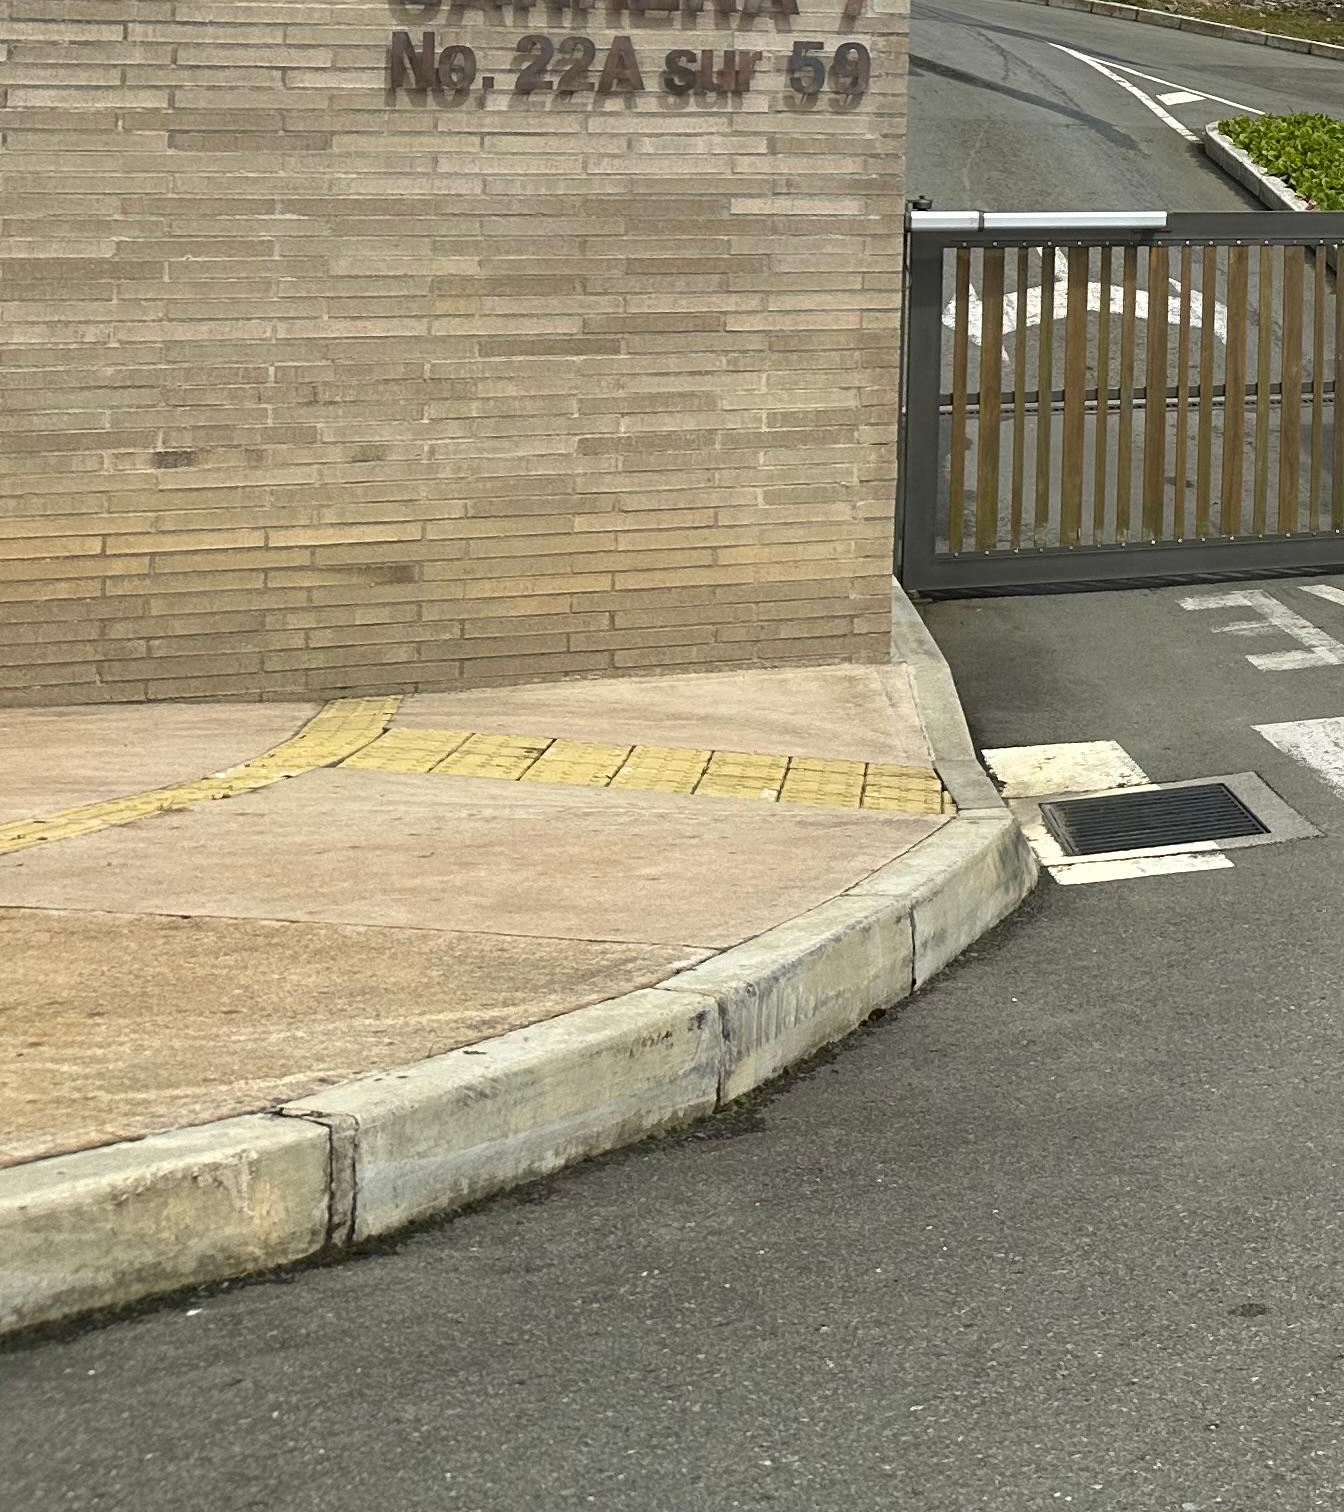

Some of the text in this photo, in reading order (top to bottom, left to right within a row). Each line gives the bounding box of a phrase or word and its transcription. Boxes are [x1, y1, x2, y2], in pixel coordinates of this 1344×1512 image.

[391, 31, 871, 95] No. 22A sur 59
